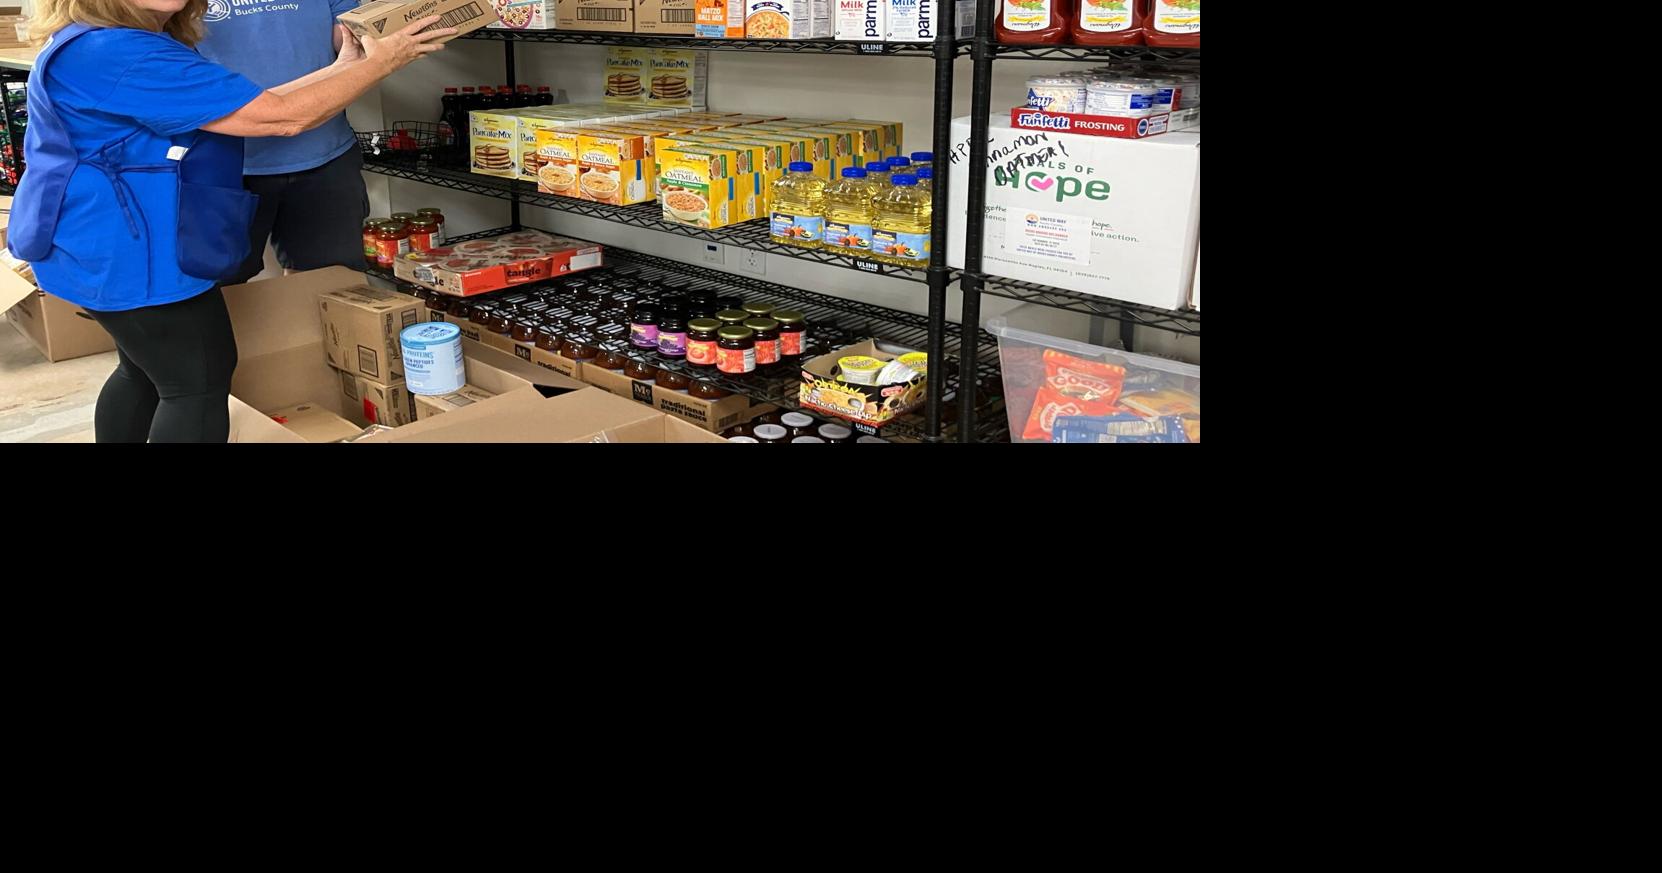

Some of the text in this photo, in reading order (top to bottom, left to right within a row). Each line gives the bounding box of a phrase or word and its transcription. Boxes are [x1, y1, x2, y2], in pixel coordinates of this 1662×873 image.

[234, 3, 299, 16] Bucks County
[840, 0, 864, 9] Milk
[403, 1, 438, 22] Newtons
[1018, 113, 1071, 129] Funfetti
[1074, 120, 1125, 132] FROSTING
[472, 127, 512, 139] Pancake Mix
[520, 132, 537, 142] Panc
[539, 148, 570, 158] OATMEAL
[581, 154, 614, 164] OATMEAL
[1075, 165, 1094, 175] OF
[665, 170, 703, 183] OATMEAL
[1106, 233, 1140, 243] action.
[857, 261, 878, 270] ULINE
[660, 398, 706, 417] traditional
[855, 423, 876, 433] ULINE
